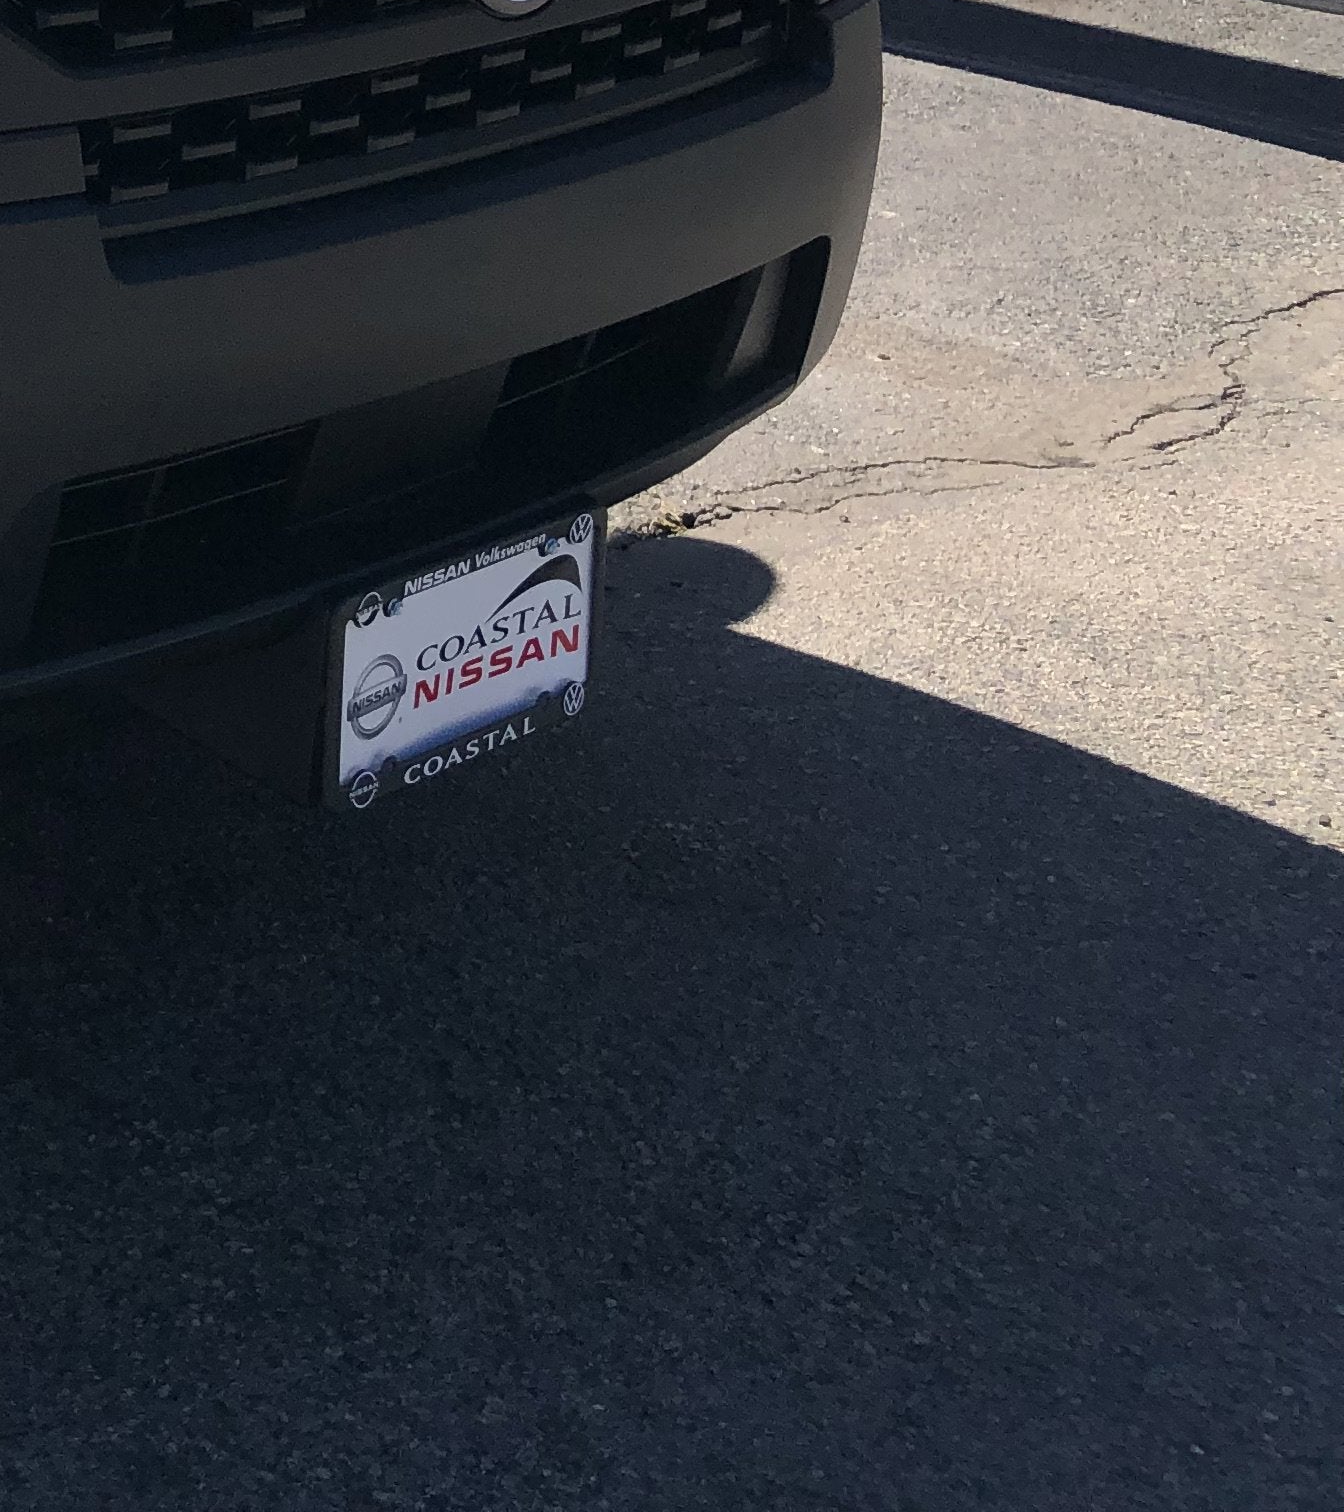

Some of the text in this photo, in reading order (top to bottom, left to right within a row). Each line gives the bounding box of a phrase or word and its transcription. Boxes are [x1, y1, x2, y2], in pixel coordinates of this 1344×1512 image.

[404, 533, 547, 596] NISSAN Volkswagen
[413, 624, 581, 710] NISSAN
[416, 593, 582, 672] COASTAL
[352, 681, 402, 714] NISSAN
[403, 716, 537, 785] COASTAL
